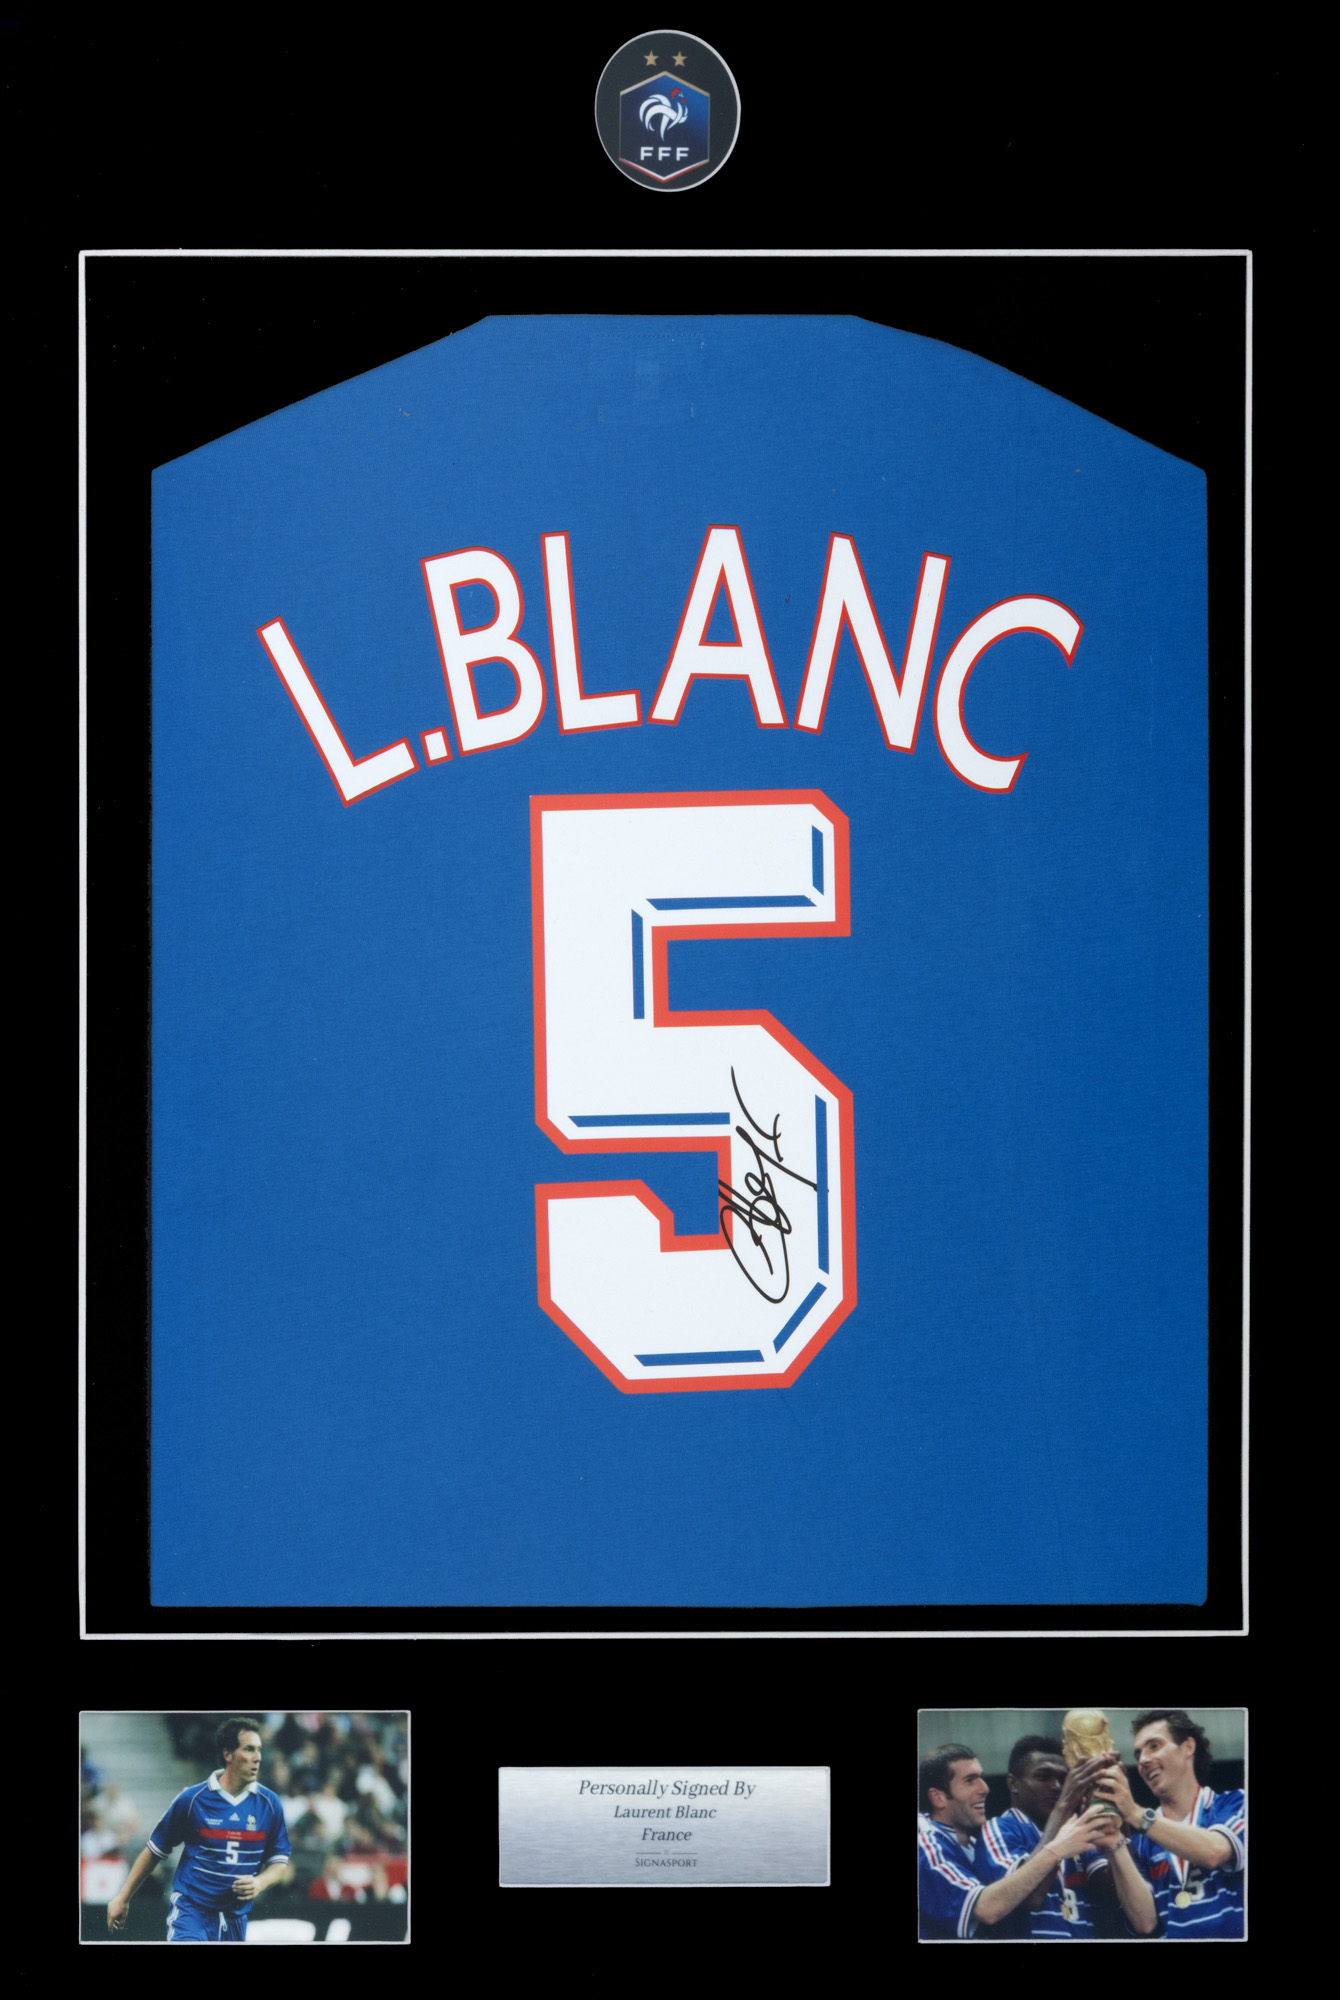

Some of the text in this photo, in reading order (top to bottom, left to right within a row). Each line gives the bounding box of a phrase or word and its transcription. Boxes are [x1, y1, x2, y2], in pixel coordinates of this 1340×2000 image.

[640, 146, 689, 161] FFF
[255, 523, 1085, 807] L.BLANC
[529, 788, 858, 1394] 5
[578, 1779, 756, 1800] Personally Signed By
[613, 1804, 717, 1819] Laurent Blanc
[641, 1828, 692, 1842] France
[225, 1840, 240, 1865] 5
